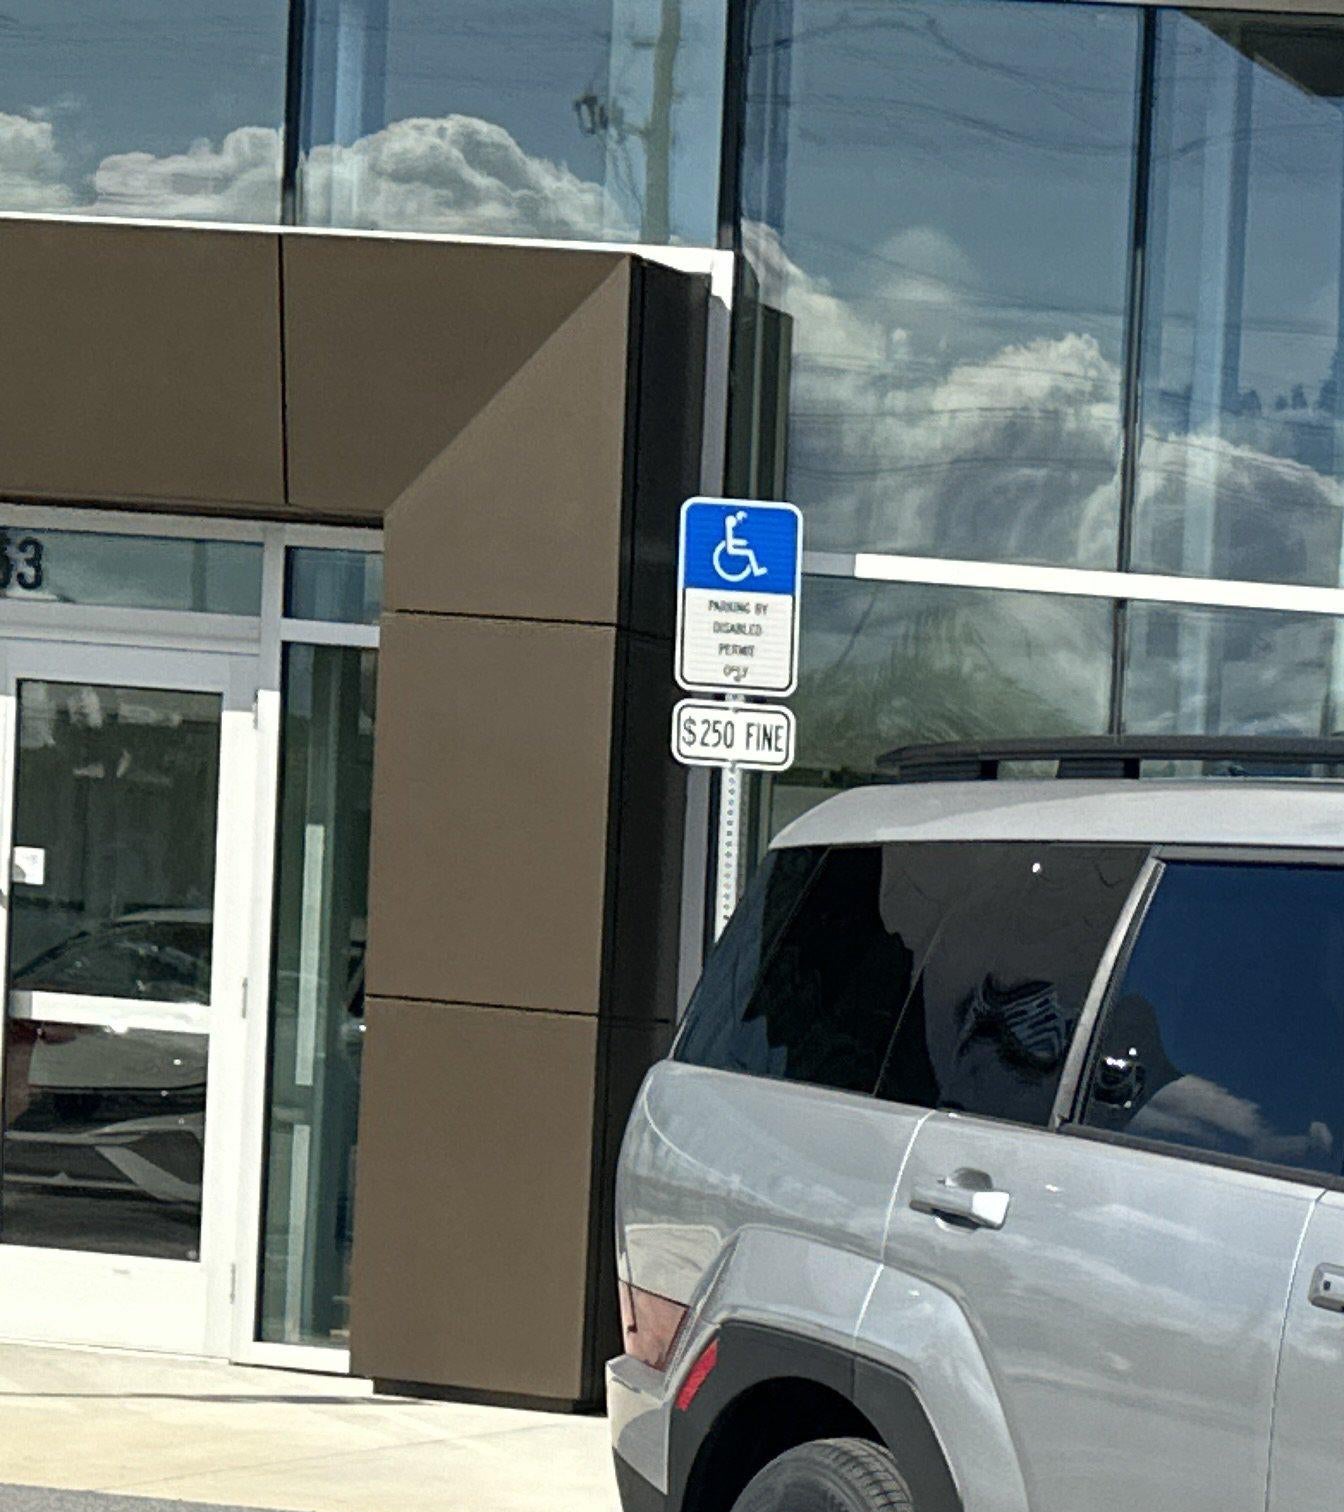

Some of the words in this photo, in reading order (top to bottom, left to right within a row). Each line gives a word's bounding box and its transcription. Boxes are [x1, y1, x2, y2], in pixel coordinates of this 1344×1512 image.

[708, 599, 751, 614] PARKING
[754, 603, 768, 615] BY
[713, 621, 762, 636] DISABLED
[718, 642, 755, 658] PERMIT
[682, 716, 735, 749] $250
[745, 722, 785, 752] FINE
